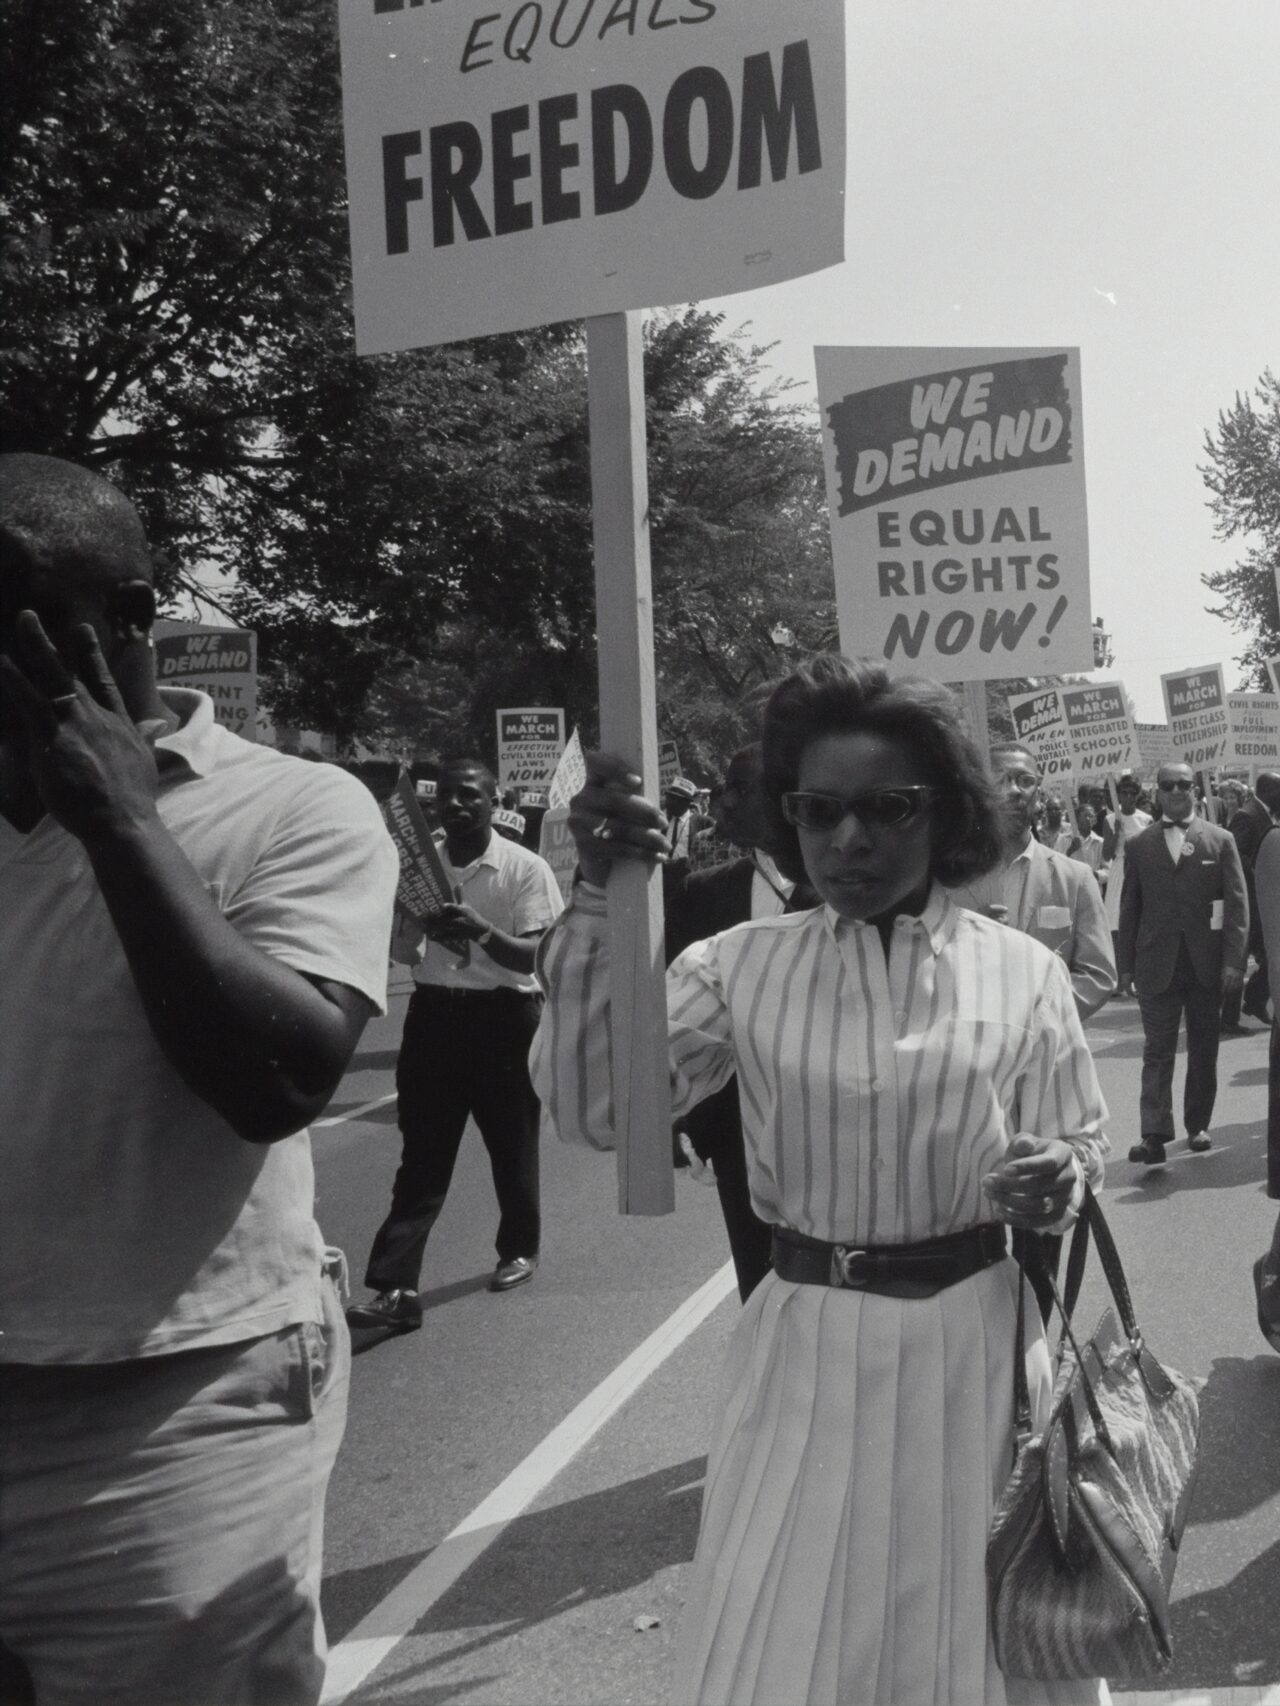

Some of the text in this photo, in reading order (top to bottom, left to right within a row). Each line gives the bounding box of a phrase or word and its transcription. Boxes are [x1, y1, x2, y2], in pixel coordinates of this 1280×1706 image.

[382, 39, 822, 256] FREEDOM
[910, 371, 994, 430] WE
[853, 406, 1063, 496] DEMAND
[877, 506, 1051, 548] EQUAL
[877, 553, 1060, 597] RIGHTS
[883, 594, 1068, 660] NOW!
[186, 635, 221, 653] WE
[162, 650, 248, 675] DEMAND
[1186, 676, 1201, 688] WE
[1033, 693, 1055, 713] WE
[1083, 691, 1102, 702] WE
[1173, 684, 1217, 706] MARCH
[1070, 699, 1119, 716] MARCH
[1188, 701, 1206, 710] FOR
[1229, 700, 1248, 709] CIVIL
[1251, 700, 1279, 710] RIGHTS
[521, 715, 539, 723] WE
[1021, 706, 1061, 734] DEMA
[1087, 712, 1107, 720] FOR
[1172, 716, 1198, 733] FIRST
[1200, 710, 1226, 726] CLASS
[1243, 716, 1263, 726] FULL
[506, 724, 555, 735] MARCH
[1028, 729, 1065, 743] AN EN
[1070, 720, 1128, 738] INTEGRATED
[1172, 723, 1229, 746] CITIZENSHIP
[507, 743, 557, 751] EFFECTIVE
[1040, 740, 1068, 753] POLICE
[1073, 734, 1131, 753] SCHOOLS
[1184, 739, 1226, 764] NOW!
[1235, 743, 1277, 756] REEDOM
[501, 751, 561, 760] CIVIL RIGHTS
[1034, 749, 1070, 762] RUTALIT
[1082, 747, 1131, 770] NOW!
[389, 792, 419, 846] MARCH
[416, 854, 445, 902] WASHINGT
[410, 874, 441, 915] FREEDO
